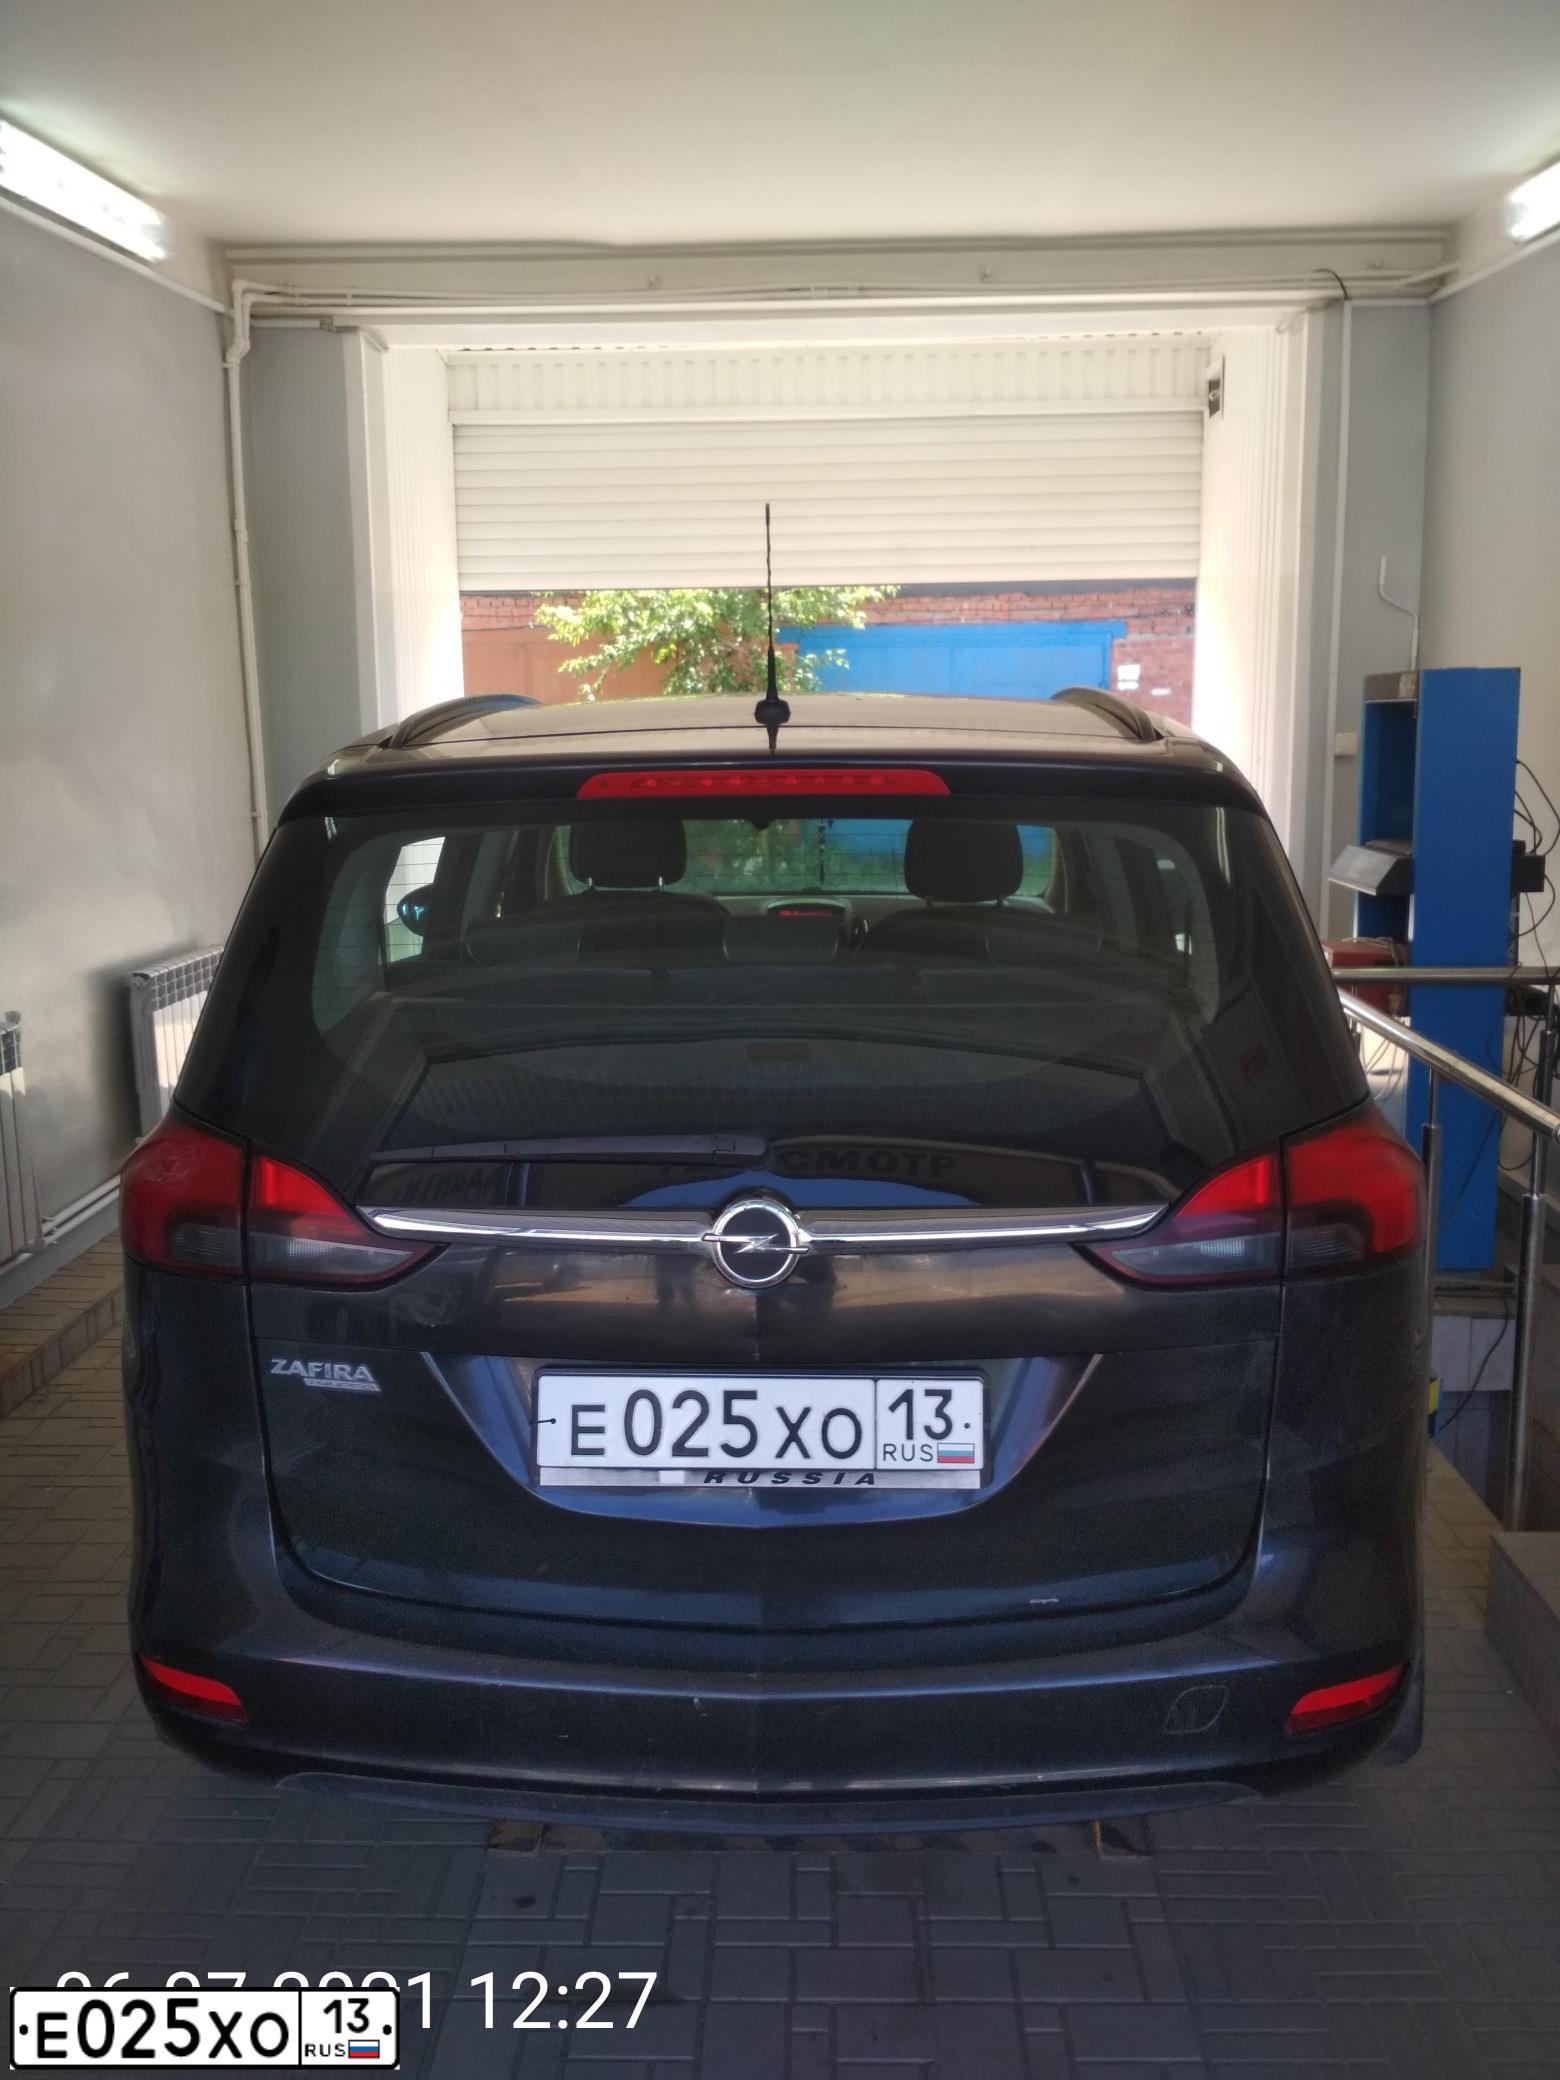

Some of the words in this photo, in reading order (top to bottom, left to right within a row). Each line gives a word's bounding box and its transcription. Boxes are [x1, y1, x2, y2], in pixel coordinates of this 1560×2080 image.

[270, 1359, 375, 1382] ZAFIRA
[888, 1388, 954, 1441] 13
[883, 1443, 934, 1462] RUS
[703, 1469, 876, 1487] RUSSIA
